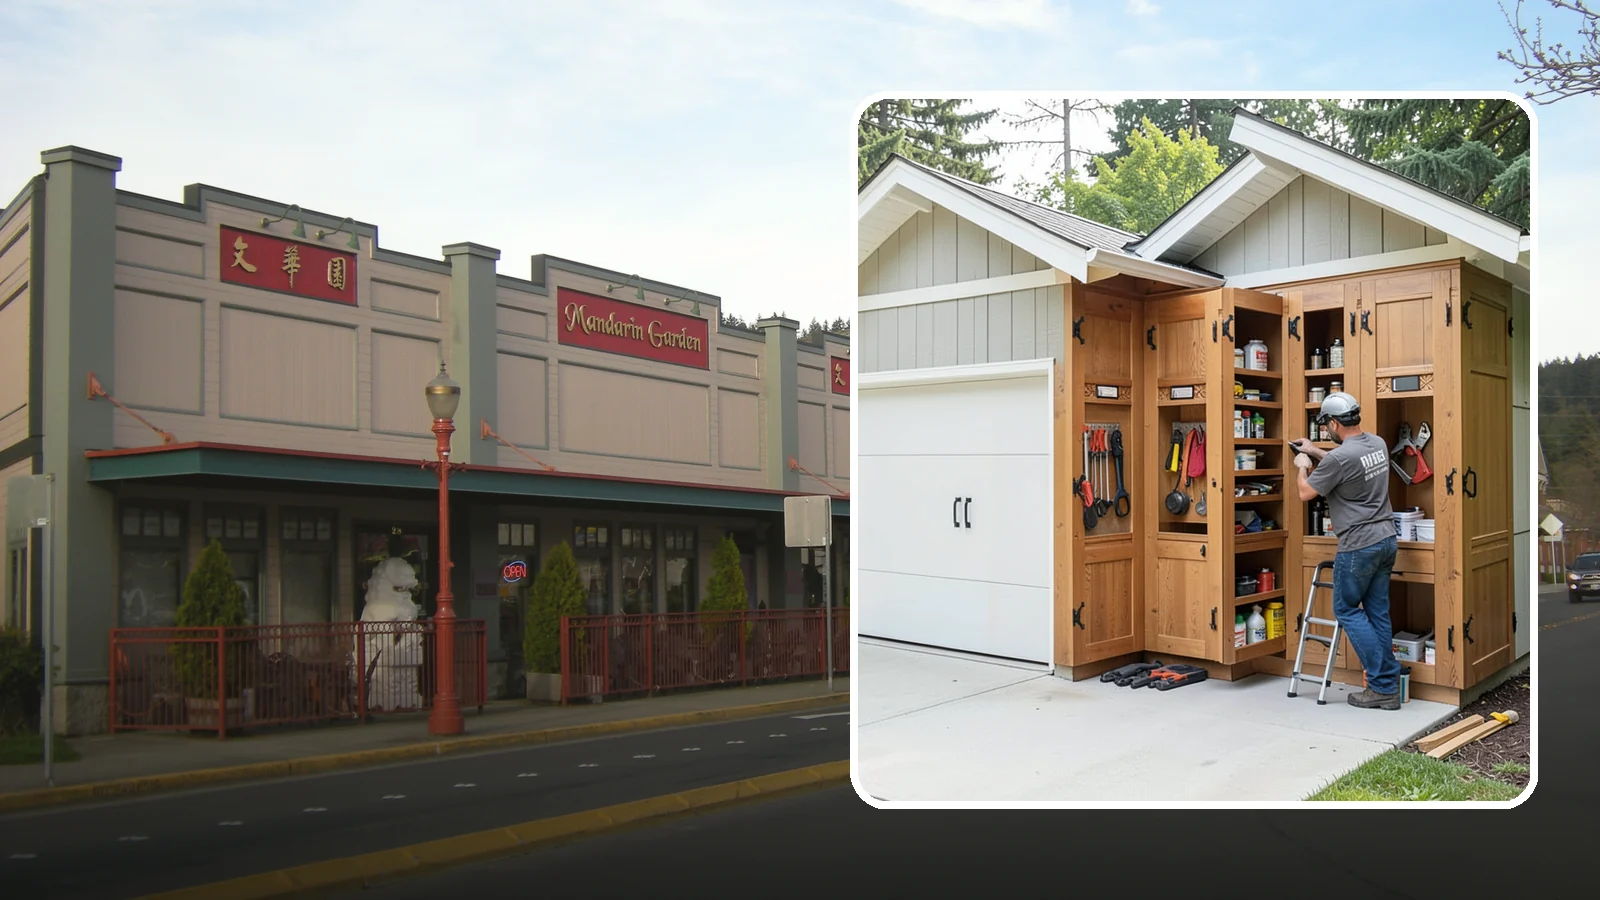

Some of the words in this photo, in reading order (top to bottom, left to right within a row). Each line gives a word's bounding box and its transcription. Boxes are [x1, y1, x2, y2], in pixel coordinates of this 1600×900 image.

[231, 236, 346, 290] 文華園
[564, 302, 644, 341] Mandarin
[648, 320, 702, 352] Garden
[835, 363, 846, 386] 文
[503, 565, 526, 578] OPEN
